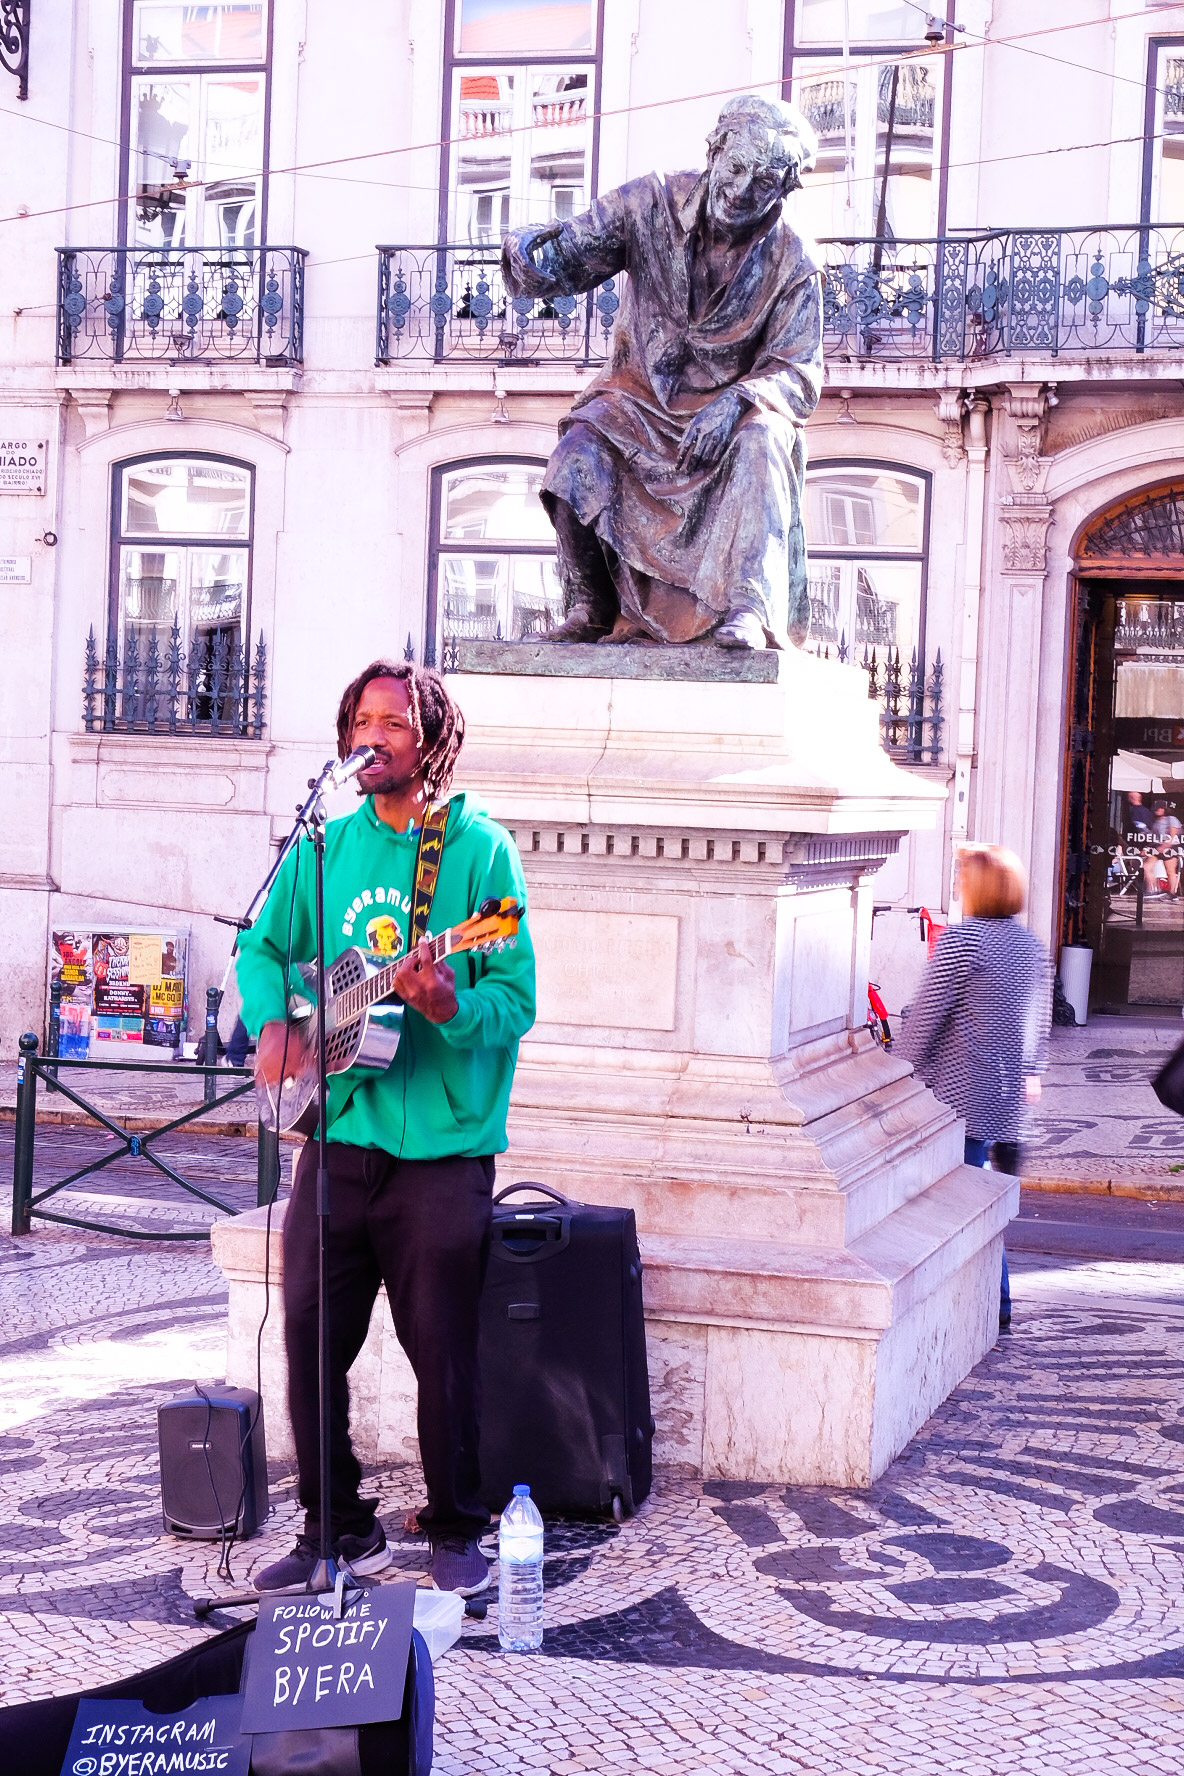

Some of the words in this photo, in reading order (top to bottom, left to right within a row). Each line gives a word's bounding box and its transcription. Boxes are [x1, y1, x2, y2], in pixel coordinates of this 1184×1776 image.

[1, 442, 27, 450] ARGO
[1127, 832, 1184, 844] FIDELIDAD
[272, 1604, 334, 1622] FOLLOW
[344, 1603, 372, 1618] ME
[274, 1617, 388, 1655] SPOTIFY
[273, 1662, 375, 1707] BYERA
[81, 1719, 217, 1746] INSTAGRAM
[72, 1751, 229, 1776] @BYERAMUSIC
